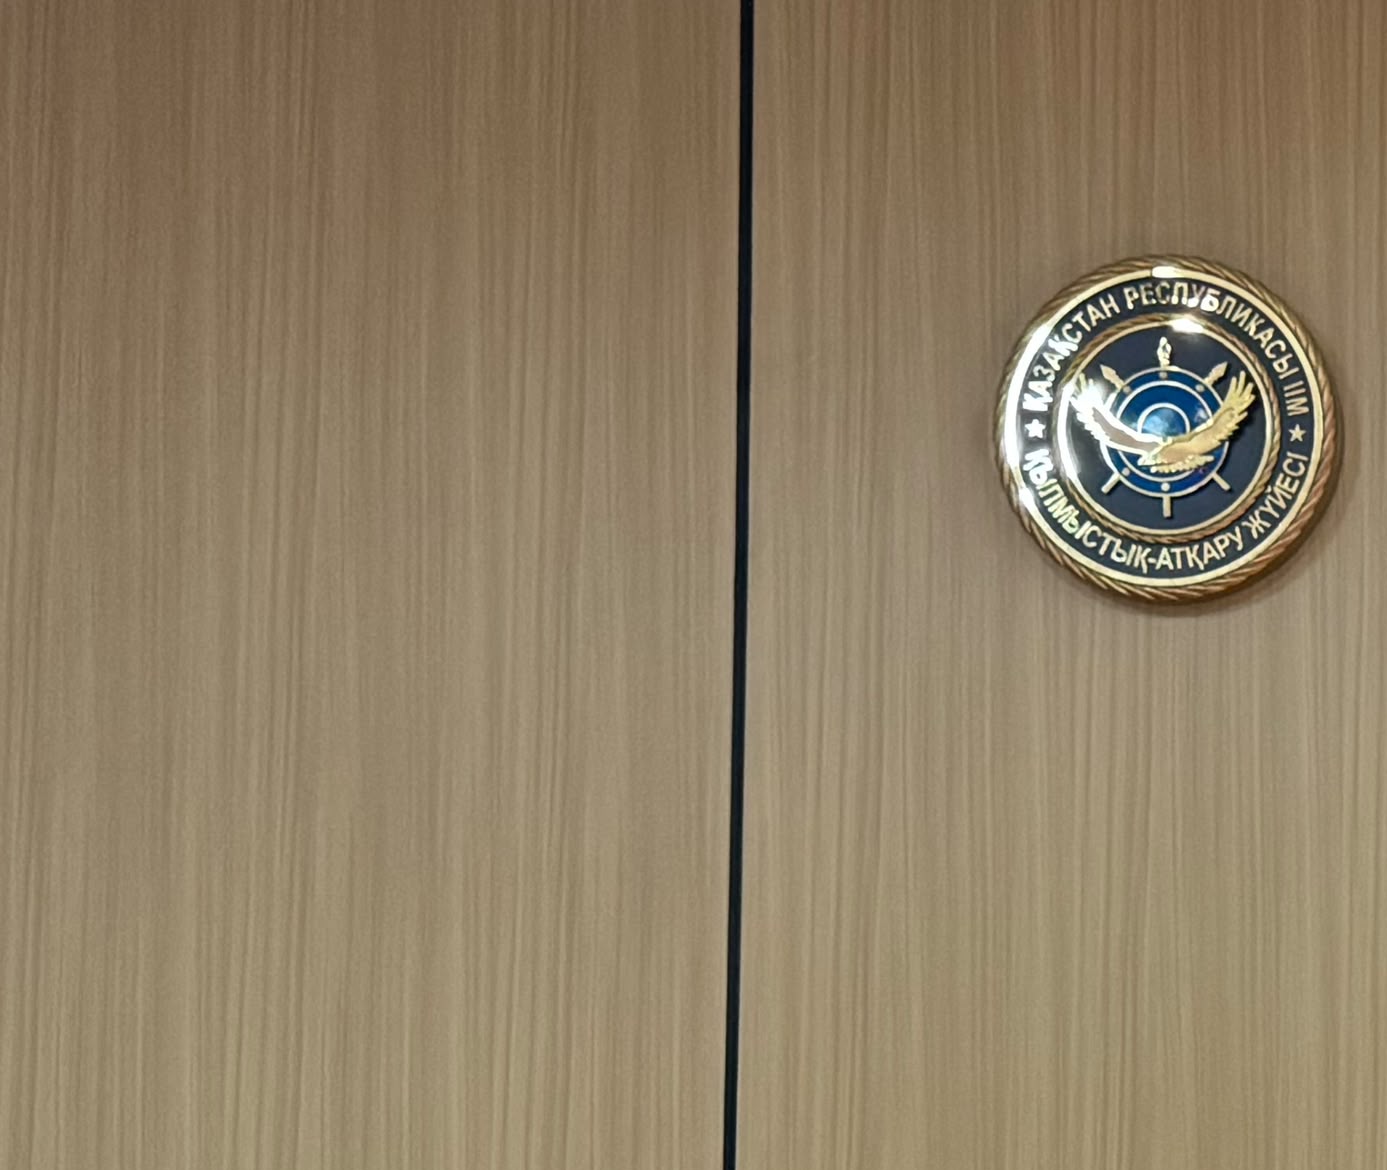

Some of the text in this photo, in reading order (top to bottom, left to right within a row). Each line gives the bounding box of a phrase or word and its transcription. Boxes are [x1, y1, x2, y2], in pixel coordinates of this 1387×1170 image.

[1023, 293, 1121, 412] ҚАЗАҚСТАН
[1123, 281, 1299, 380] РЕСПУБЛИКАСЫ
[1023, 448, 1309, 573] ҚЫЛМЫСТЫҚ-АТҚАРУ ЖҮЙЕСІ
